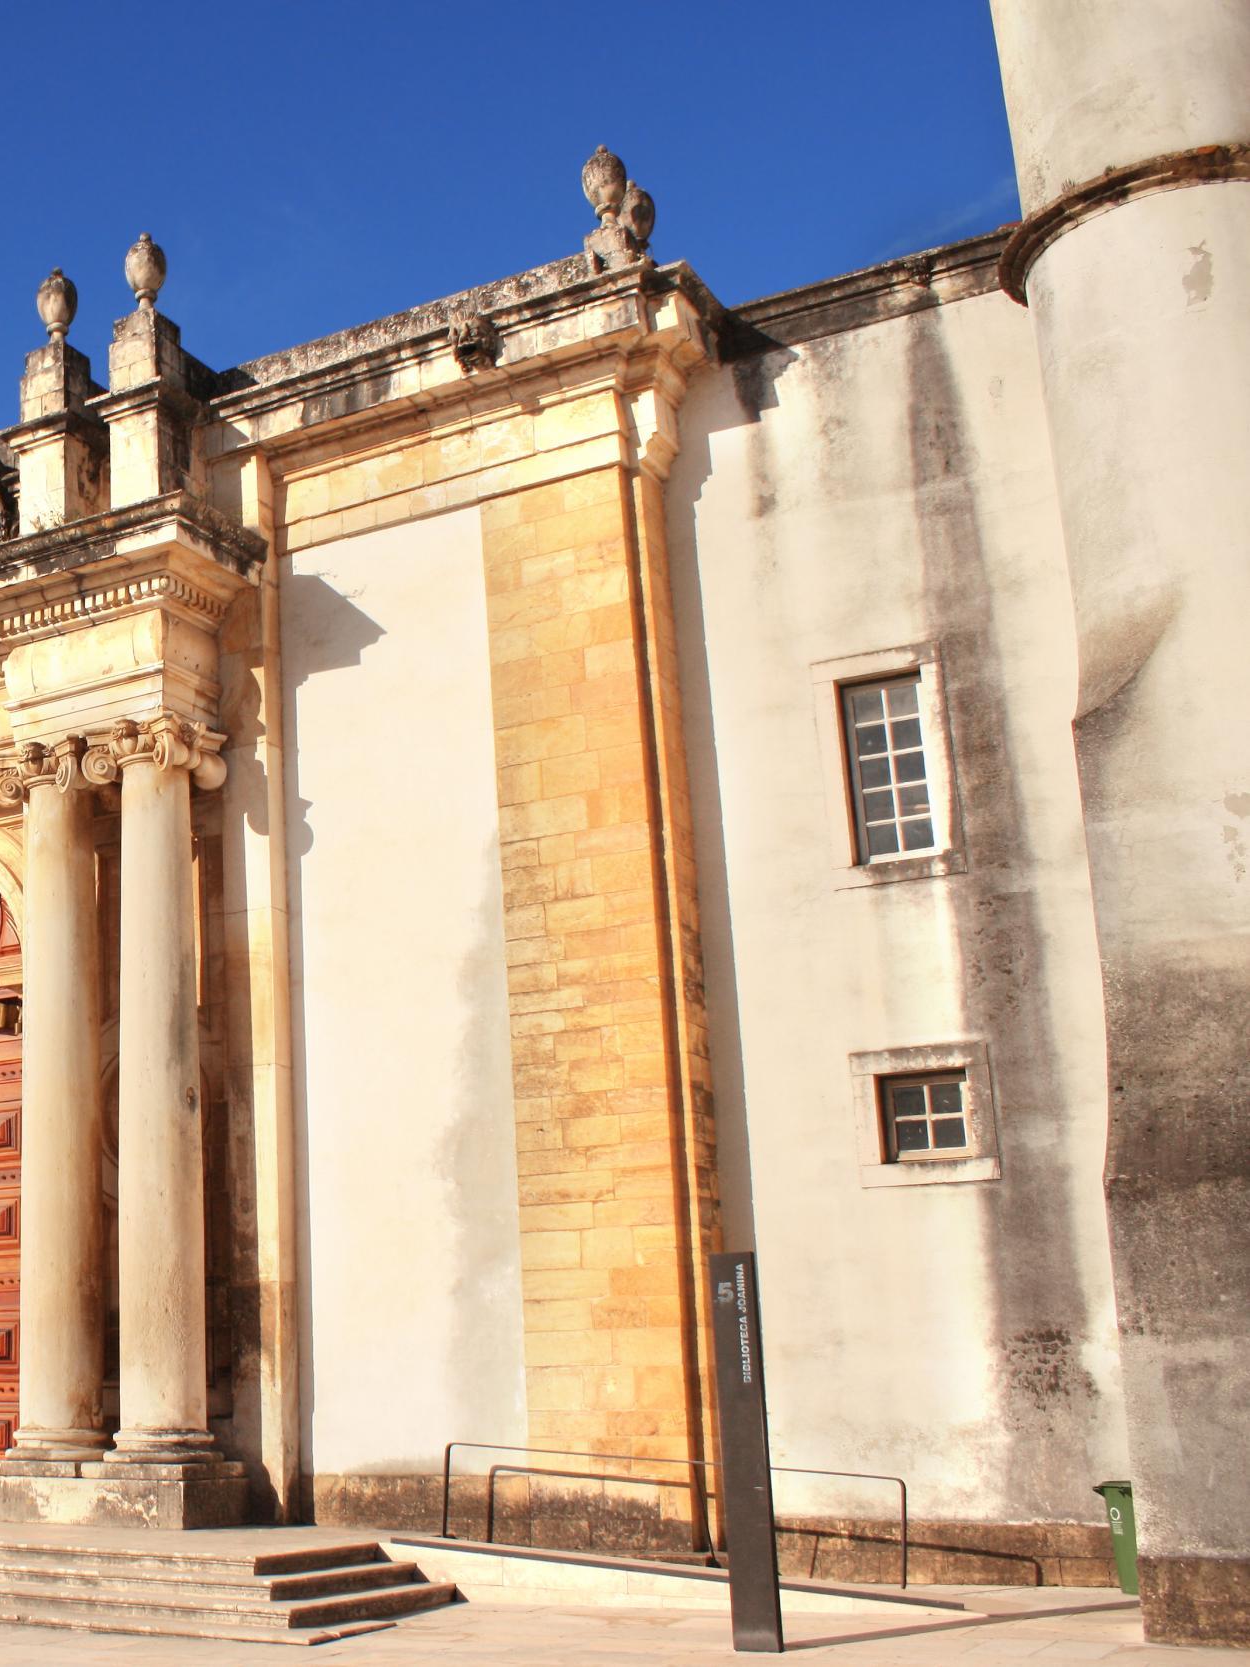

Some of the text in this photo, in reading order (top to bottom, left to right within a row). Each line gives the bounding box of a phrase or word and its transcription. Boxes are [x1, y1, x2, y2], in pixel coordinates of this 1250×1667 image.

[717, 1282, 734, 1303] 5
[735, 1263, 751, 1384] BIBLIOTECA JOANINA
